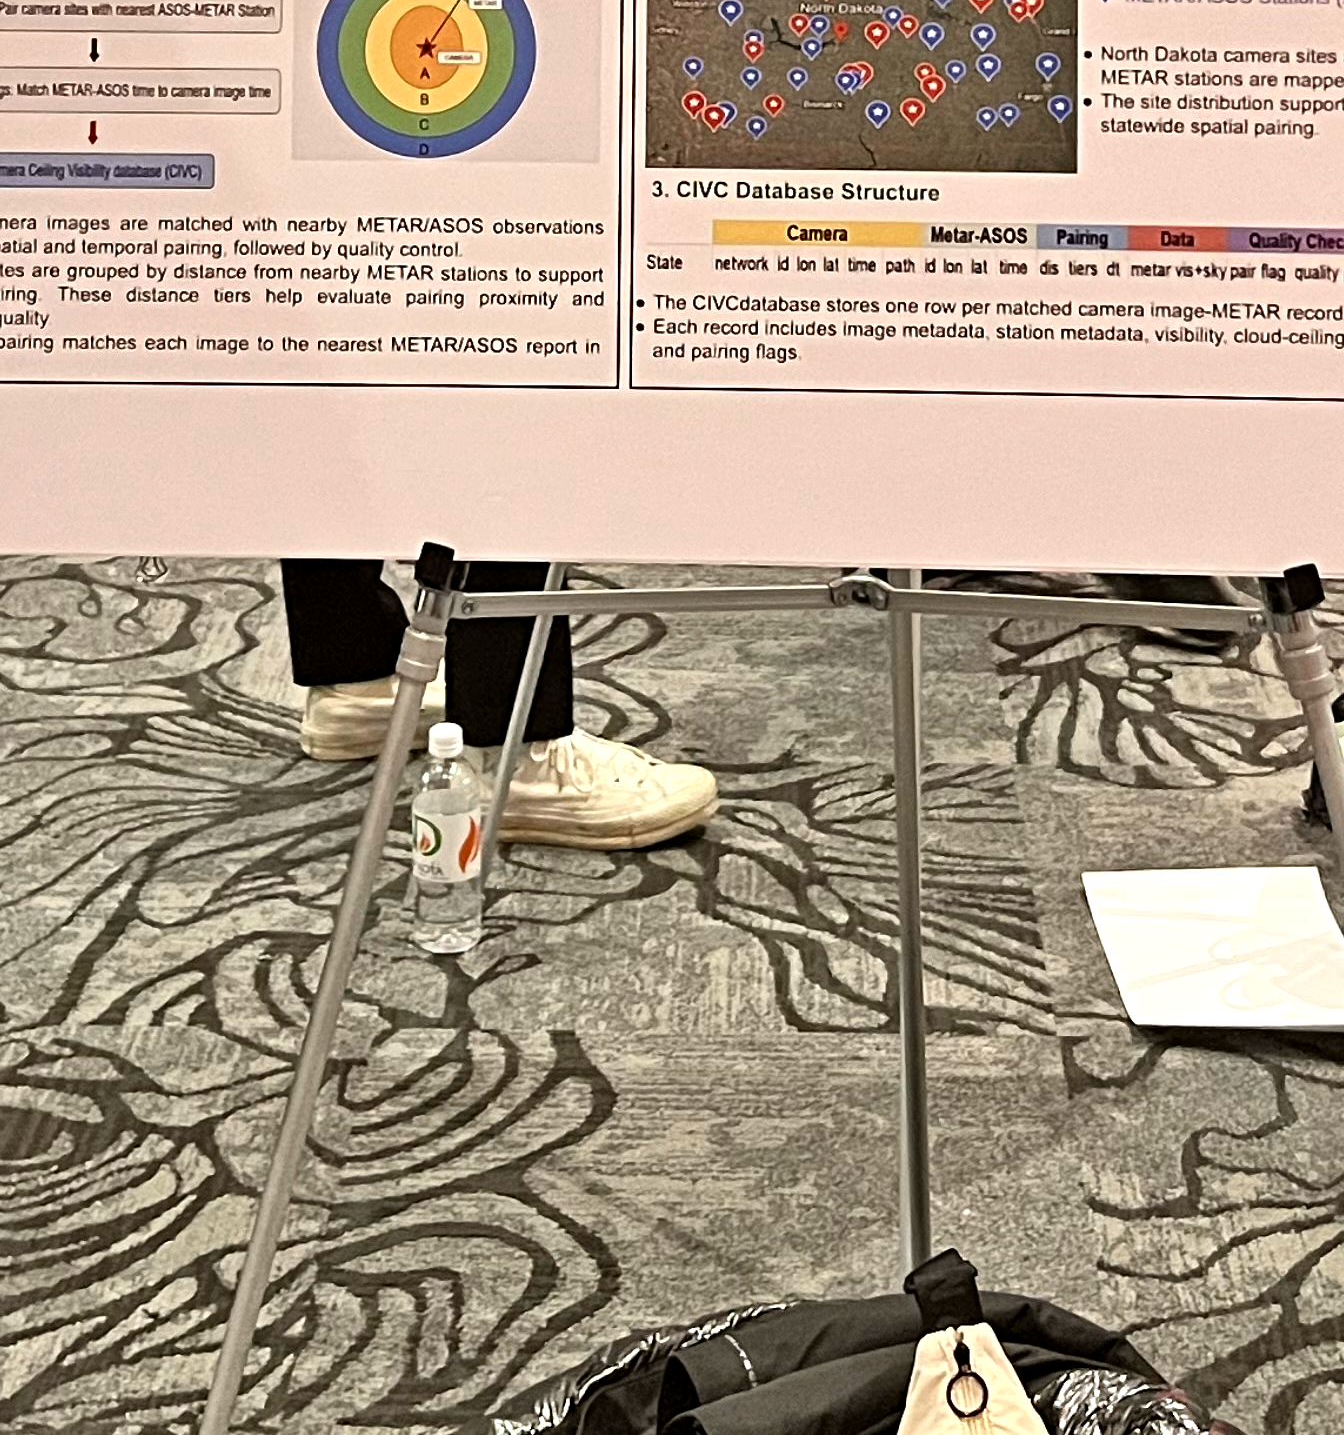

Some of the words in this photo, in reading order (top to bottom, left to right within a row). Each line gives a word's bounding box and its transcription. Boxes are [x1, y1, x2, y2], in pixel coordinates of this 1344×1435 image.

[420, 67, 430, 79] A
[420, 93, 429, 105] B
[419, 118, 429, 130] C
[419, 143, 429, 156] D
[652, 181, 669, 197] 3.
[677, 181, 728, 198] CIVC
[737, 182, 833, 199] Database
[842, 183, 939, 201] Structure
[787, 225, 847, 241] Camera
[931, 226, 1027, 244] Metar-ASOS
[1056, 229, 1109, 250] Pairing
[1160, 230, 1195, 248] Data
[1249, 232, 1301, 252] Quality
